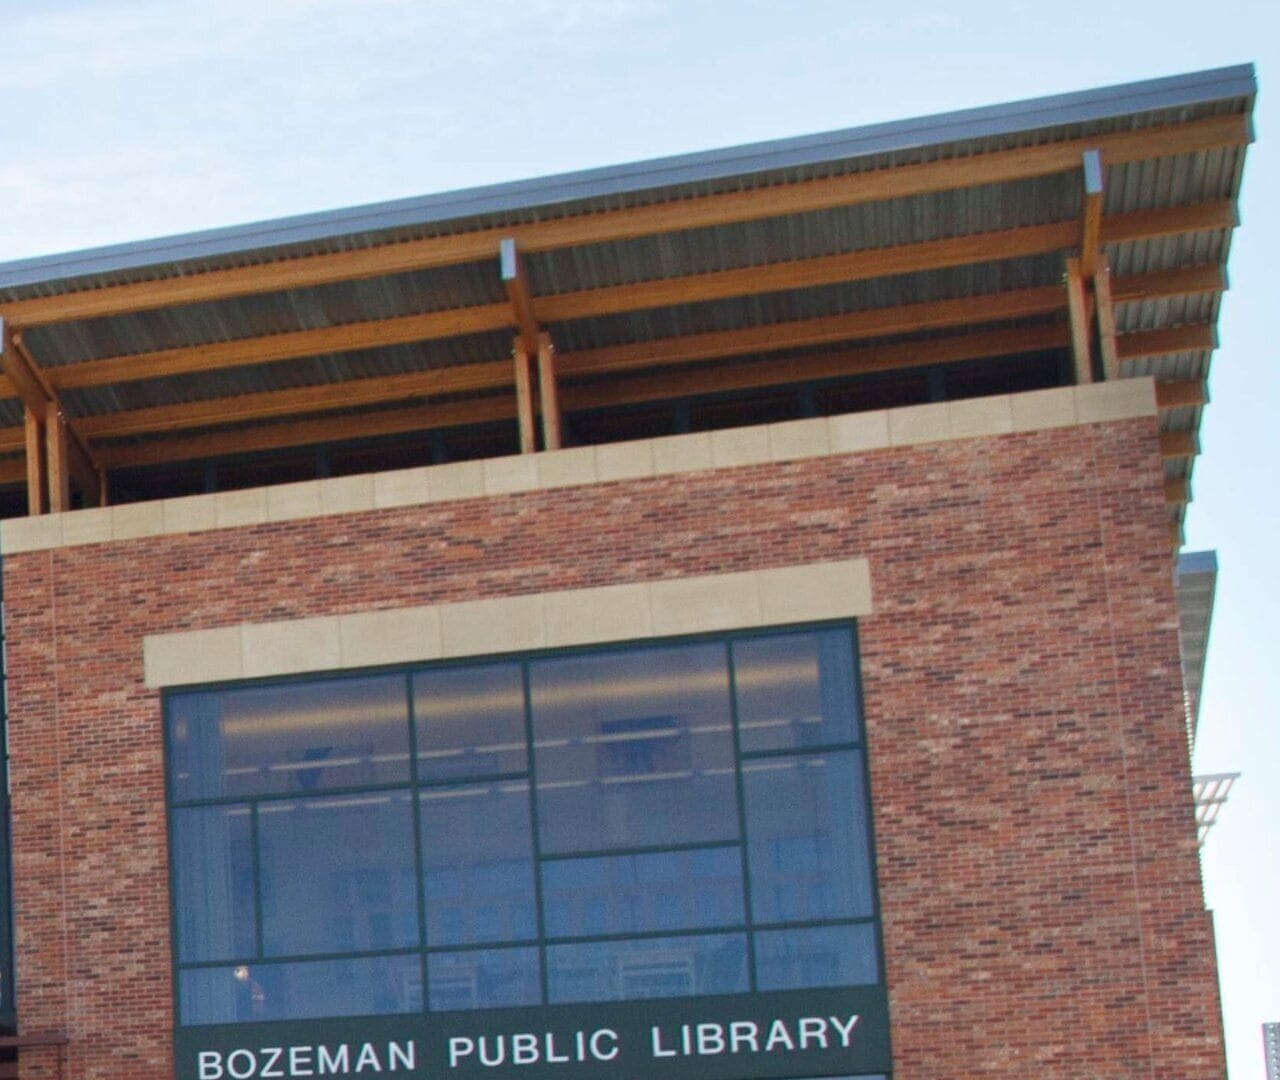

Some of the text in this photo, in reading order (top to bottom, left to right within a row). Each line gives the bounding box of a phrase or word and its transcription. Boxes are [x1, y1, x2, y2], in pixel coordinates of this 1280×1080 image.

[198, 1015, 860, 1080] BOZEMAN PUBLIC LIBRARY
